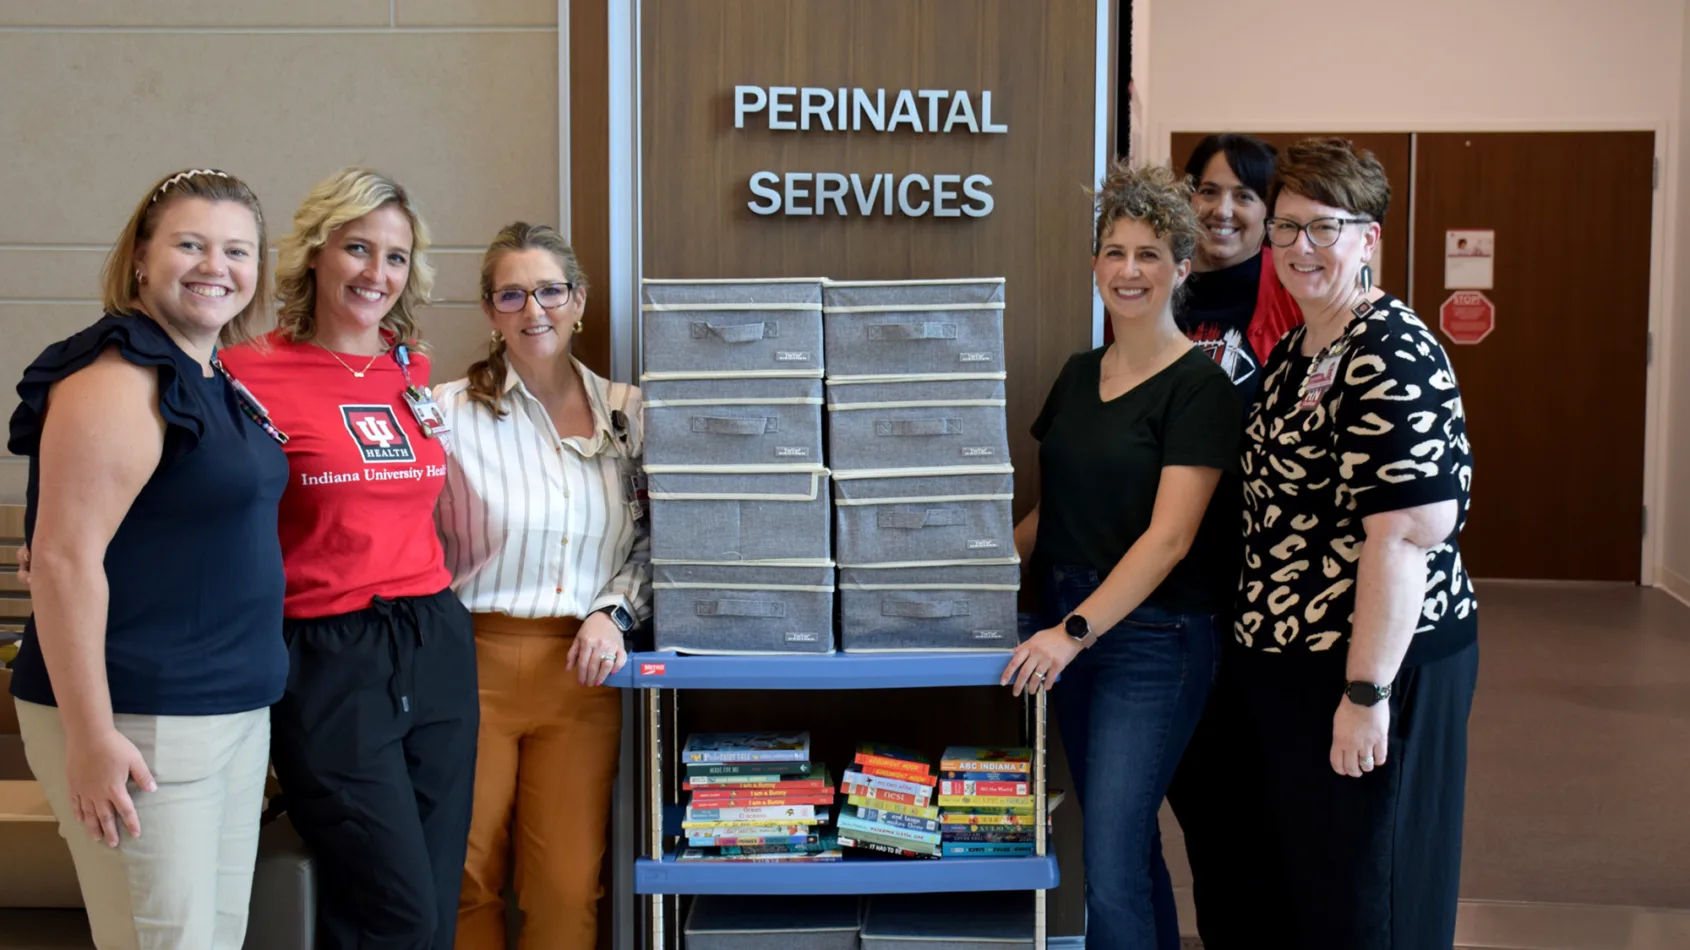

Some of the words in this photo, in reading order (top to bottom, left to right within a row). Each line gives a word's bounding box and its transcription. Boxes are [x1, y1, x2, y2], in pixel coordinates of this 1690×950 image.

[734, 85, 1008, 133] PERINATAL
[747, 170, 995, 218] SERVICES
[365, 449, 409, 458] HEALTH
[301, 472, 360, 485] Indiana
[364, 467, 424, 481] University
[959, 762, 977, 770] ABC
[980, 763, 1016, 771] INDIANA
[883, 791, 905, 802] nest
